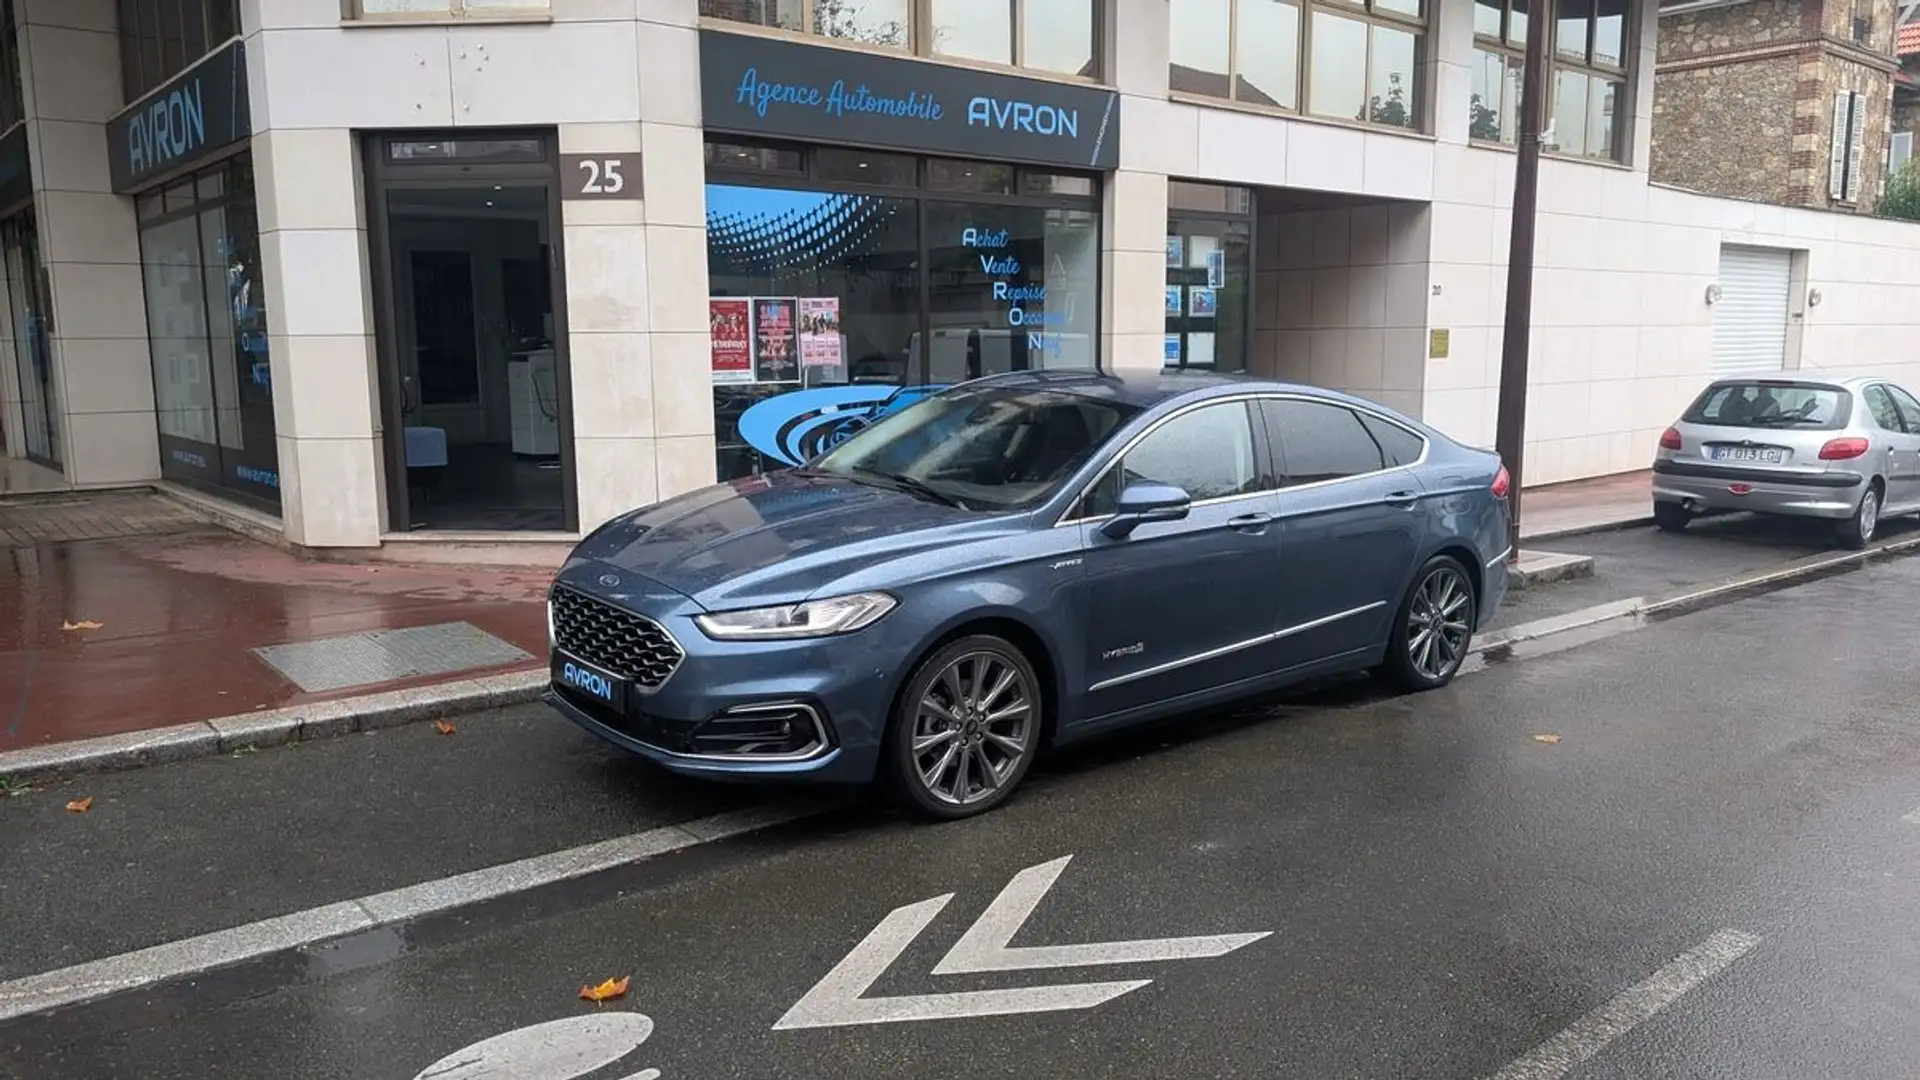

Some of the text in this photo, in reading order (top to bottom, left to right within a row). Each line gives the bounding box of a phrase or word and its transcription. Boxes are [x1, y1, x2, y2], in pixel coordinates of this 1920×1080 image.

[737, 67, 823, 116] Agence
[825, 79, 943, 120] Automobile
[967, 96, 1078, 138] AVRON
[129, 78, 206, 175] AVRON
[579, 159, 624, 193] 25
[962, 227, 1008, 249] Achat
[980, 254, 1021, 275] Vente
[993, 281, 1048, 308] Reprise
[1009, 307, 1067, 327] Occa
[1028, 332, 1063, 358] Nf
[564, 662, 612, 701] AVRON
